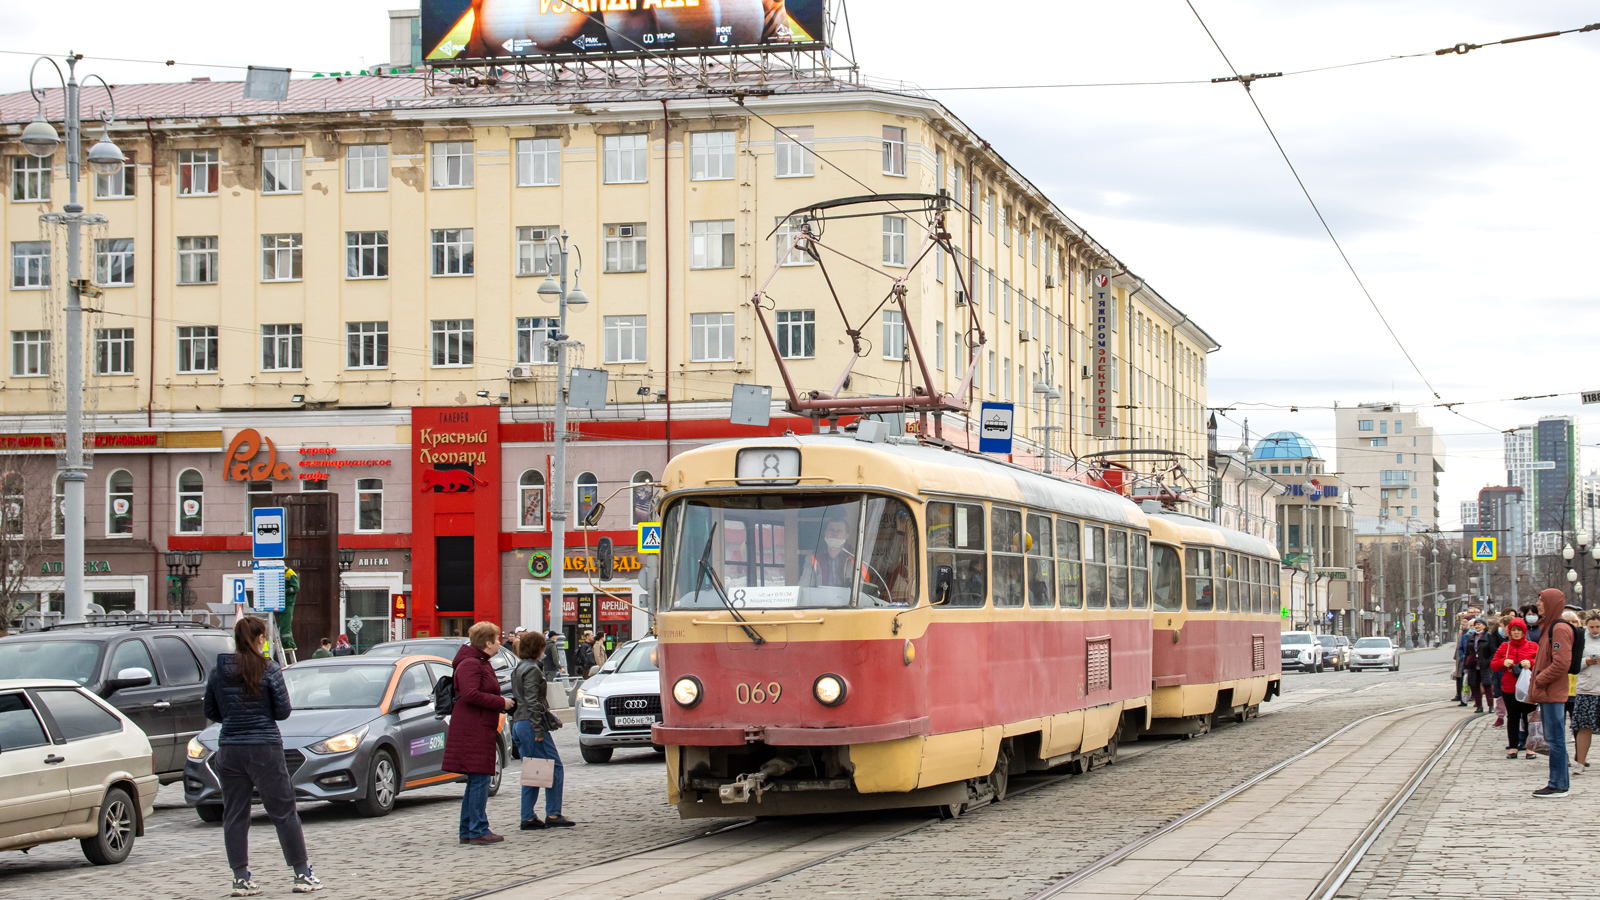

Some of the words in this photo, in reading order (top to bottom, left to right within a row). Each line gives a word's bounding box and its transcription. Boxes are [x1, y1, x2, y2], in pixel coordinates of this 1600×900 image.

[439, 411, 469, 423] ГАЛЕРЕЯ
[419, 428, 488, 448] Красный
[223, 428, 293, 481] Рада
[298, 446, 336, 456] первое
[419, 448, 487, 466] Леопард
[298, 458, 391, 469] вегетарианское
[762, 453, 780, 484] 8
[298, 470, 329, 483] кафе
[41, 560, 112, 572] АПКА
[358, 558, 389, 567] АПТЕКА
[236, 581, 244, 601] P
[731, 589, 747, 608] 8
[601, 601, 629, 611] АРЕНДА
[736, 681, 782, 705] 069
[428, 734, 444, 750] 50%
